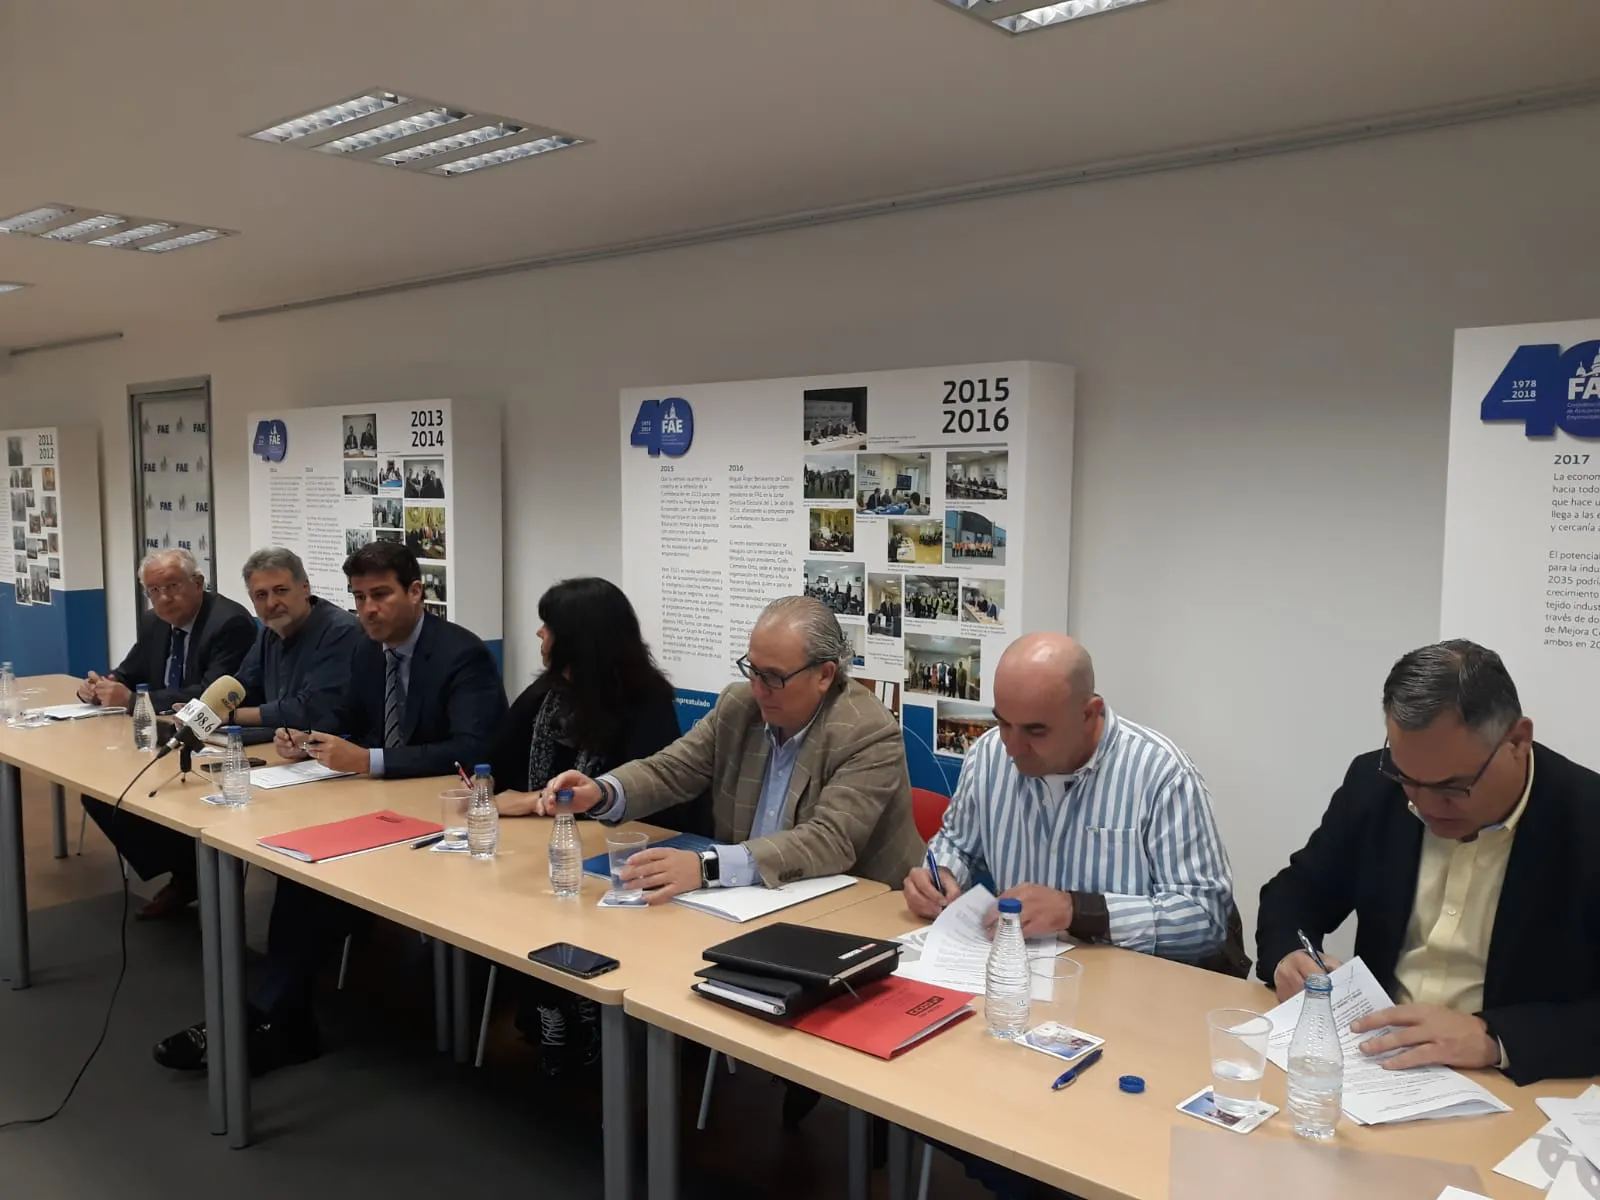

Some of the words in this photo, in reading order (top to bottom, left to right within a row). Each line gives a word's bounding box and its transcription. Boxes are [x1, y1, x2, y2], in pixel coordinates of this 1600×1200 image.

[1512, 380, 1537, 389] 1978
[942, 377, 1009, 404] 2015
[1512, 390, 1537, 399] 2018
[411, 409, 444, 427] 2013
[942, 406, 1009, 433] 2016
[157, 424, 170, 434] FAE
[193, 423, 206, 433] FAE
[661, 419, 684, 434] FAE
[38, 434, 54, 446] 2011
[269, 434, 281, 445] FAE
[411, 429, 445, 447] 2014
[39, 447, 54, 460] 2012
[1554, 454, 1590, 465] 2017
[143, 463, 156, 473] FAE
[176, 463, 189, 473] FAE
[728, 464, 744, 472] 2016
[1553, 472, 1564, 481] La
[1552, 485, 1576, 493] hacia
[1579, 485, 1600, 494] todo
[160, 501, 172, 511] FAE
[196, 502, 209, 512] FAE
[1551, 499, 1569, 507] que
[1571, 497, 1593, 506] hace
[1551, 510, 1572, 520] llega
[1581, 510, 1594, 519] las
[1550, 524, 1556, 532] y
[1558, 522, 1596, 532] cercanía
[146, 538, 159, 549] FAE
[178, 540, 192, 550] FAE
[1549, 550, 1558, 559] El
[1548, 564, 1567, 573] para
[1569, 564, 1577, 572] la
[1580, 564, 1600, 573] indu
[1548, 575, 1574, 585] 2035
[1546, 588, 1600, 599] crecimiento
[1546, 600, 1572, 611] tejido
[1545, 613, 1572, 622] través
[1574, 614, 1586, 623] de
[1588, 615, 1600, 624] do
[1544, 625, 1556, 634] de
[1558, 626, 1590, 637] Mejora
[1544, 638, 1573, 648] ambos
[1575, 640, 1587, 648] en
[194, 712, 215, 733] 98.6
